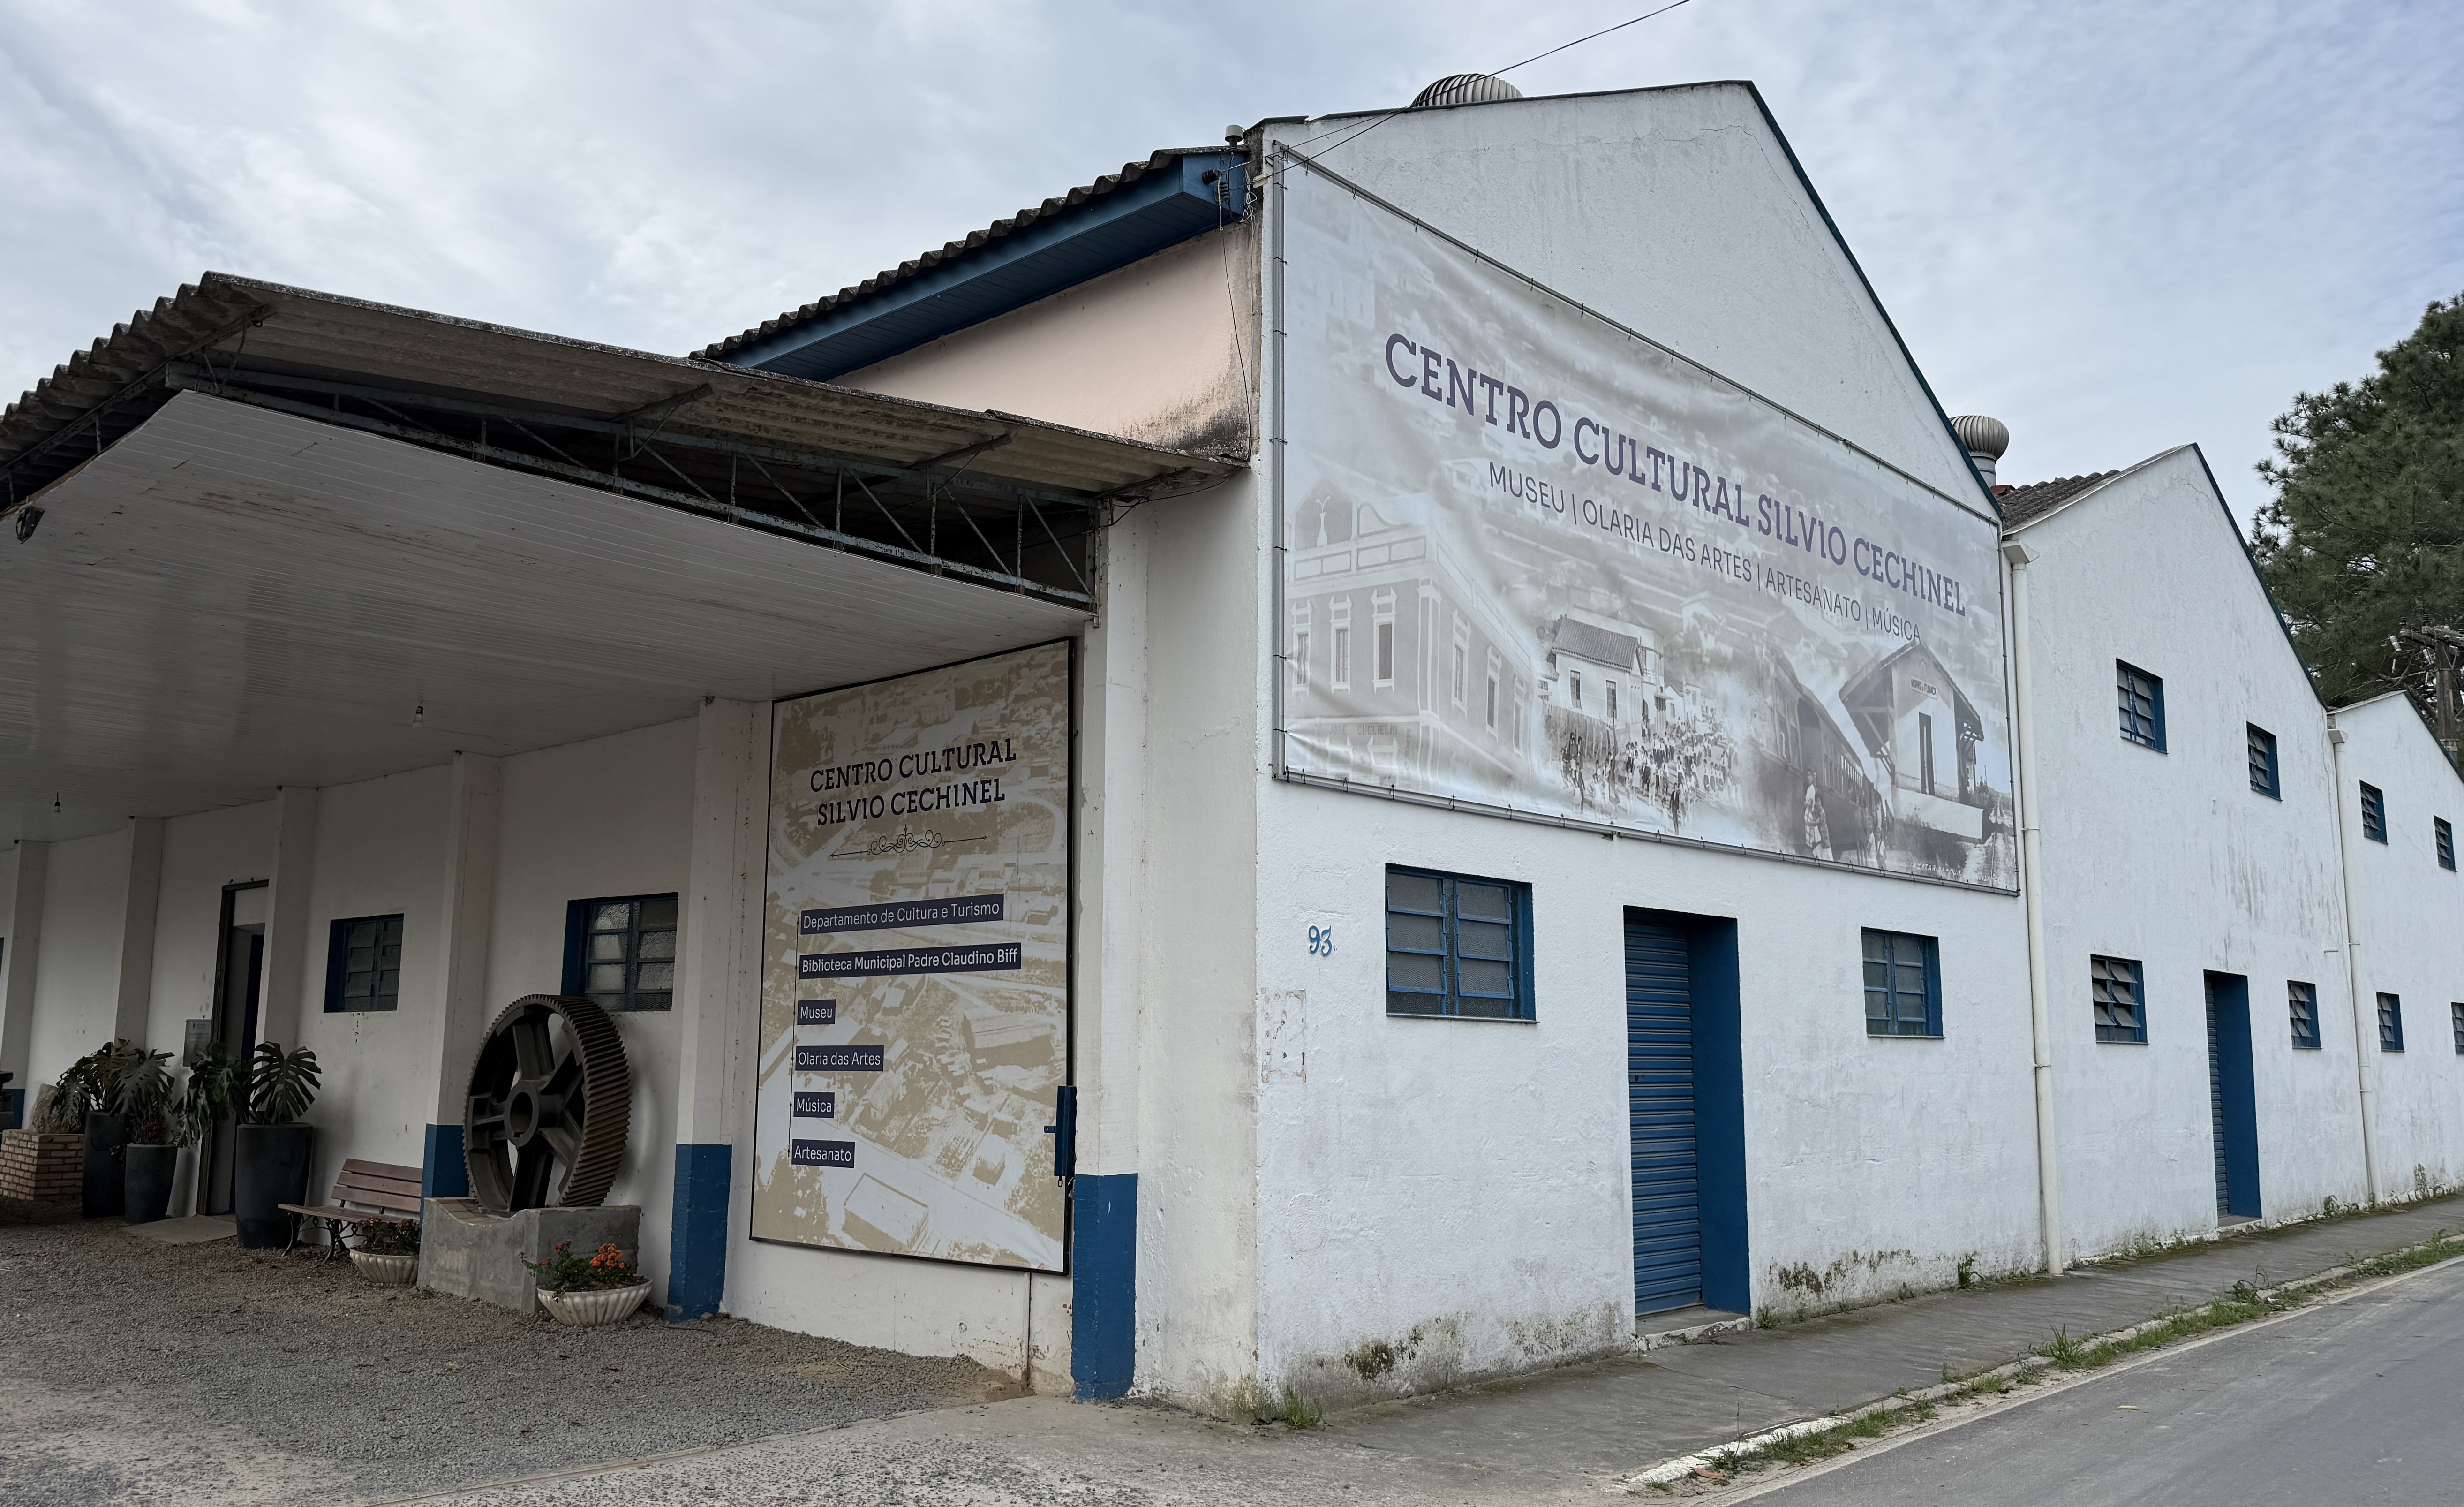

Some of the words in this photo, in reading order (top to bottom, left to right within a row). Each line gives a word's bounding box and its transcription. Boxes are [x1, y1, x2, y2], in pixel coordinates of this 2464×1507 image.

[1385, 333, 1562, 449] CENTRO
[1574, 417, 1750, 528] CULTURAL
[1758, 493, 1846, 566] SILVIO
[1853, 537, 1966, 617] CECHINEL
[1489, 461, 1564, 513] MUSEU
[1582, 499, 1654, 548] OLARIA
[1659, 527, 1695, 562] DAS
[1701, 544, 1752, 582] ARTES
[1765, 568, 1861, 621] ARTESANATO
[1872, 608, 1921, 644] MÚSICA
[810, 758, 893, 793] CENTRO
[899, 738, 1017, 778] CULTURAL
[817, 795, 885, 826] SILVIO
[891, 778, 1005, 816] CECHINEL
[803, 911, 878, 931] Departamento
[881, 909, 894, 923] de
[897, 907, 938, 922] Cultura
[941, 907, 948, 918] e
[951, 902, 1000, 917] Turismo
[1308, 925, 1333, 957] 93
[802, 959, 852, 973] Biblioteca
[854, 954, 905, 971] Municipal
[908, 953, 940, 968] Padre
[942, 950, 995, 966] Claudino
[997, 948, 1018, 963] Biff
[800, 1006, 833, 1019] Museu
[798, 1052, 828, 1066] Olaria
[830, 1052, 849, 1066] das
[851, 1052, 881, 1066] Artes
[796, 1097, 832, 1113] Música
[794, 1145, 851, 1162] Artesanato
